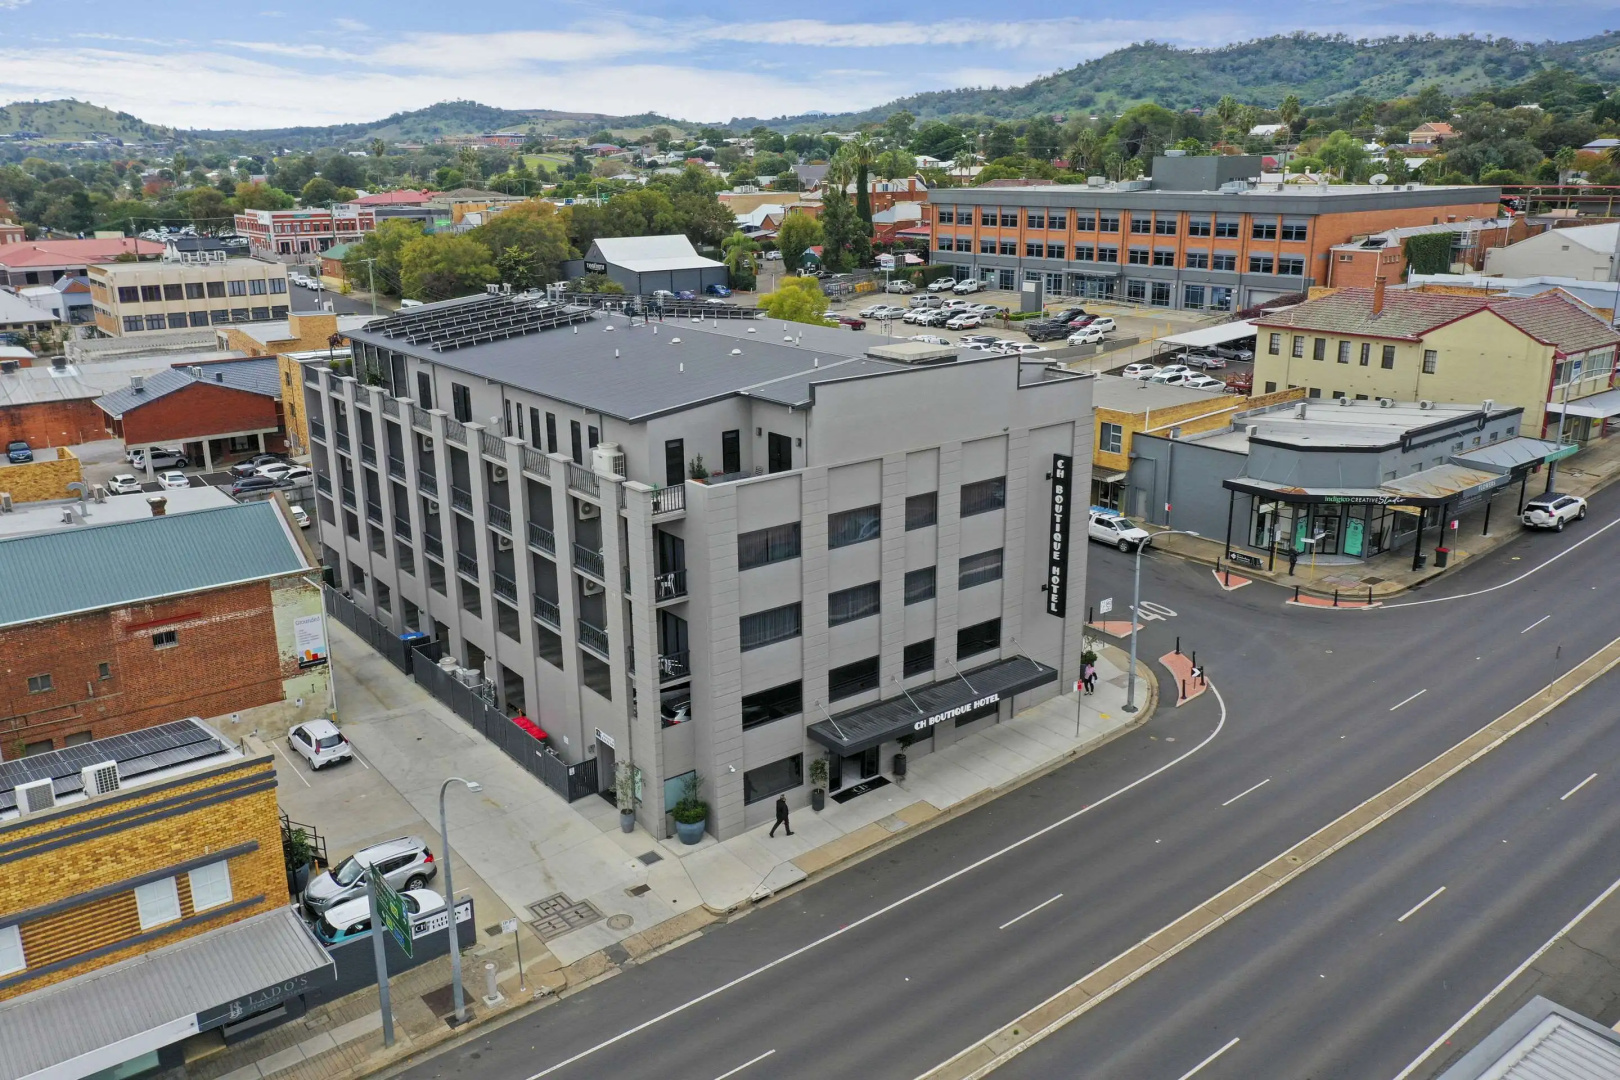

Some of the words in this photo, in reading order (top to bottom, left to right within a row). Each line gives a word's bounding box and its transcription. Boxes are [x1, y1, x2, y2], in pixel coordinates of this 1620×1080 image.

[1056, 459, 1065, 479] CH
[1053, 485, 1063, 561] BOUTIQUE
[1050, 566, 1060, 612] HOTEL
[914, 719, 926, 731] CH
[928, 703, 972, 726] BOUTIQUE
[973, 693, 1000, 709] HOTEL
[249, 975, 308, 1006] LADO'S
